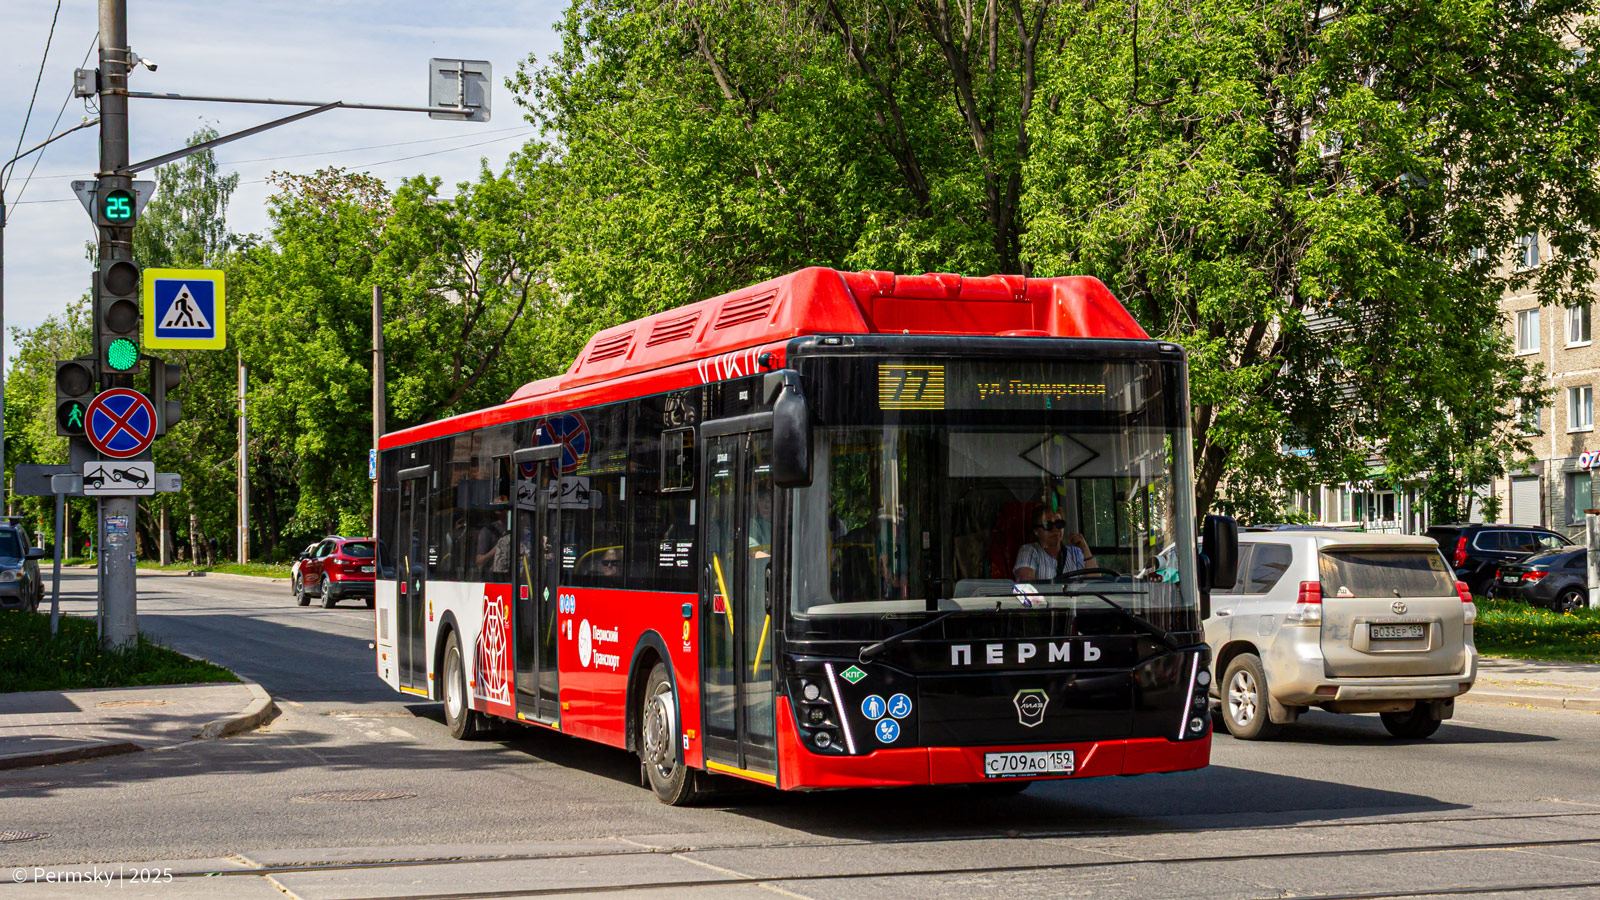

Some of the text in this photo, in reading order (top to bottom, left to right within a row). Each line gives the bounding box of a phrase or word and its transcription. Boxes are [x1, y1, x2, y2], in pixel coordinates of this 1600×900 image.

[107, 198, 130, 218] 25
[1579, 452, 1600, 468] OZ
[592, 625, 618, 645] Пермский
[592, 649, 620, 671] Транспорт
[951, 641, 1101, 665] ПЕРМЬ
[990, 752, 1070, 771] С709АО 159
